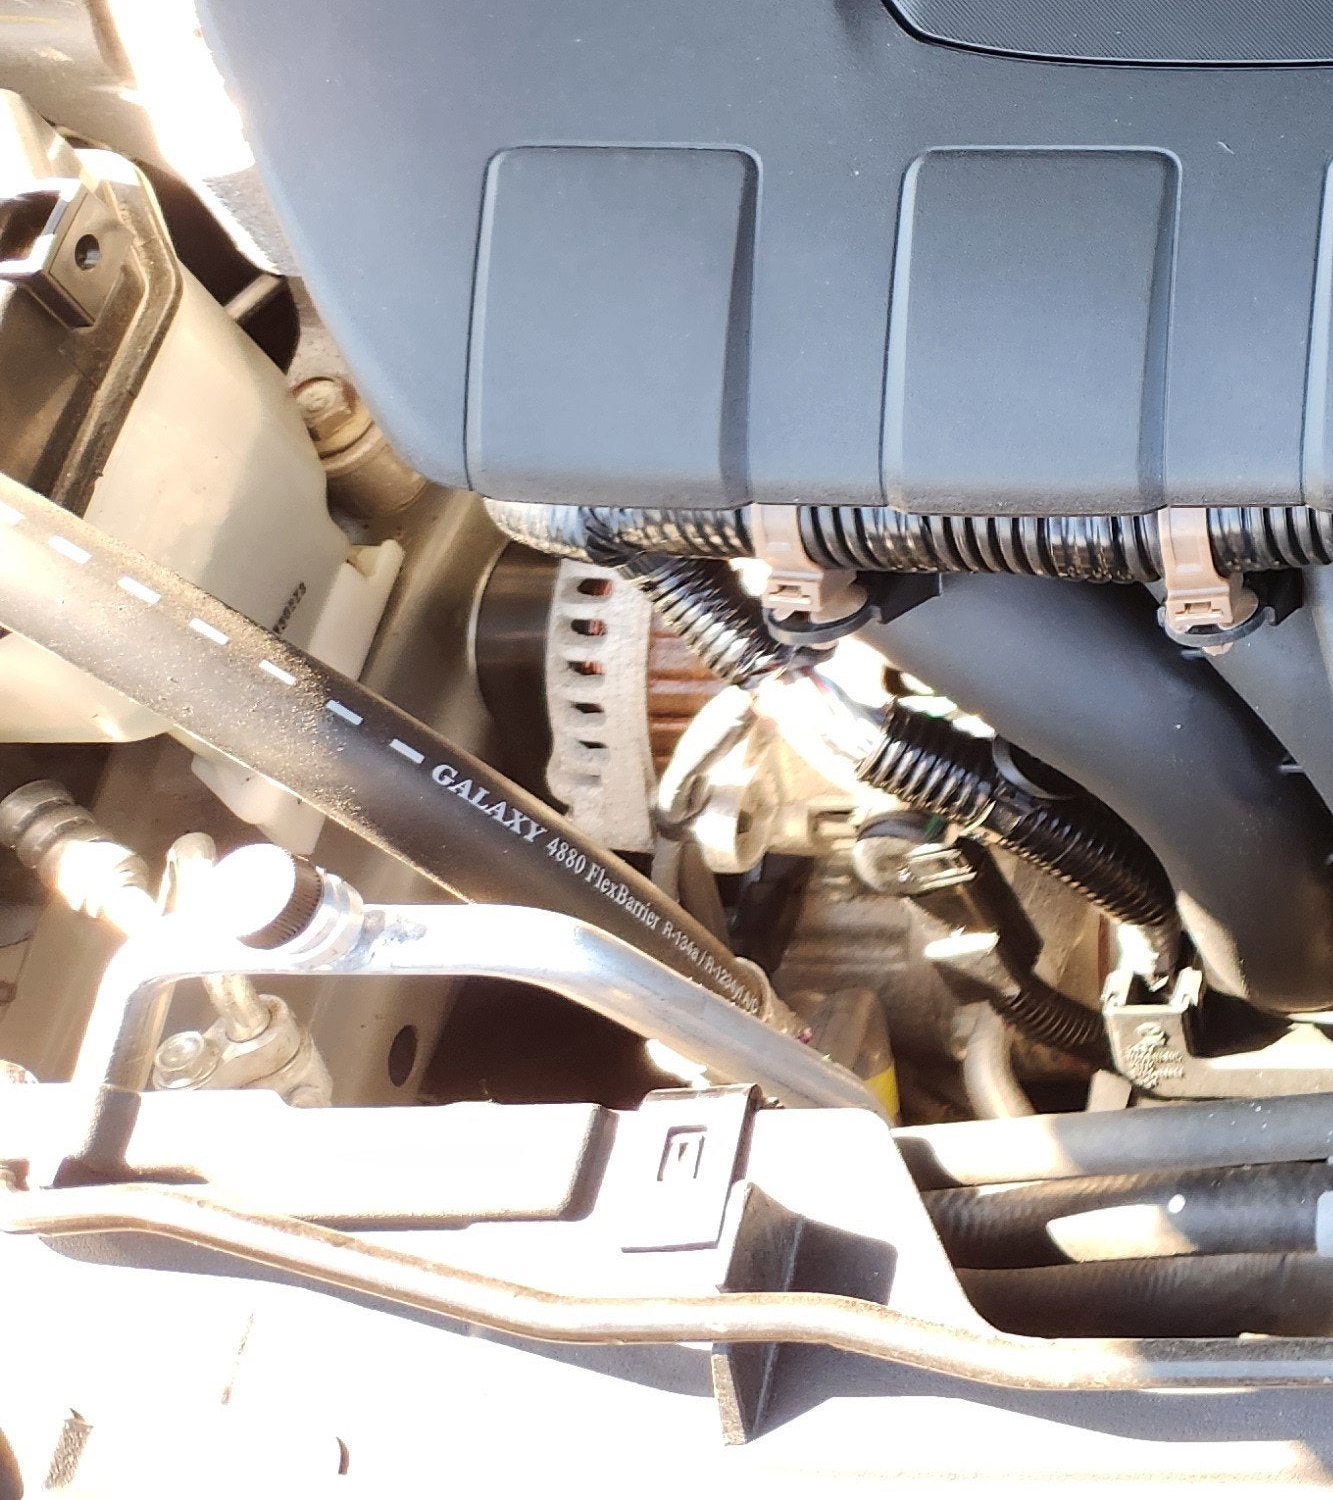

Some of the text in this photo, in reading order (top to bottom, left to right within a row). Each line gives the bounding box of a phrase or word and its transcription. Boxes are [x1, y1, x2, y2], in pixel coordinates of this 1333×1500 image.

[432, 764, 547, 842] GALAXY
[546, 837, 586, 875] 4880
[584, 862, 661, 930] FlexBarrier
